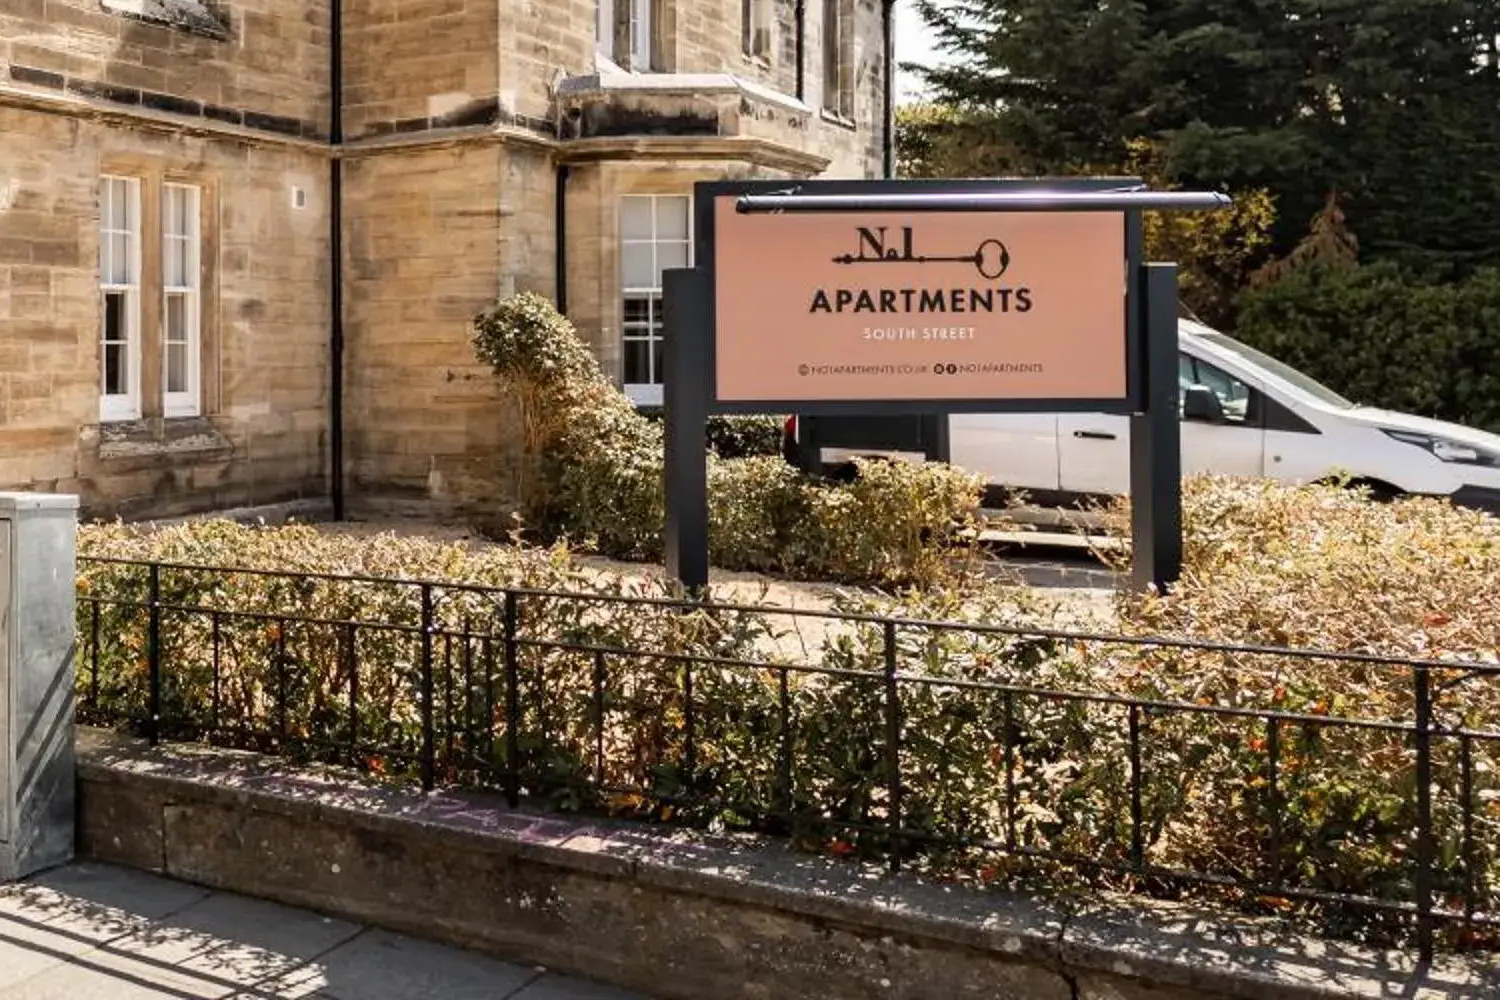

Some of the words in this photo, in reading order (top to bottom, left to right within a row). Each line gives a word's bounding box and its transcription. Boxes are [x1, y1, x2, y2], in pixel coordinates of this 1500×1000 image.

[808, 287, 1034, 313] APARTMENTS
[862, 327, 916, 341] SOUTH
[921, 327, 976, 341] STREET
